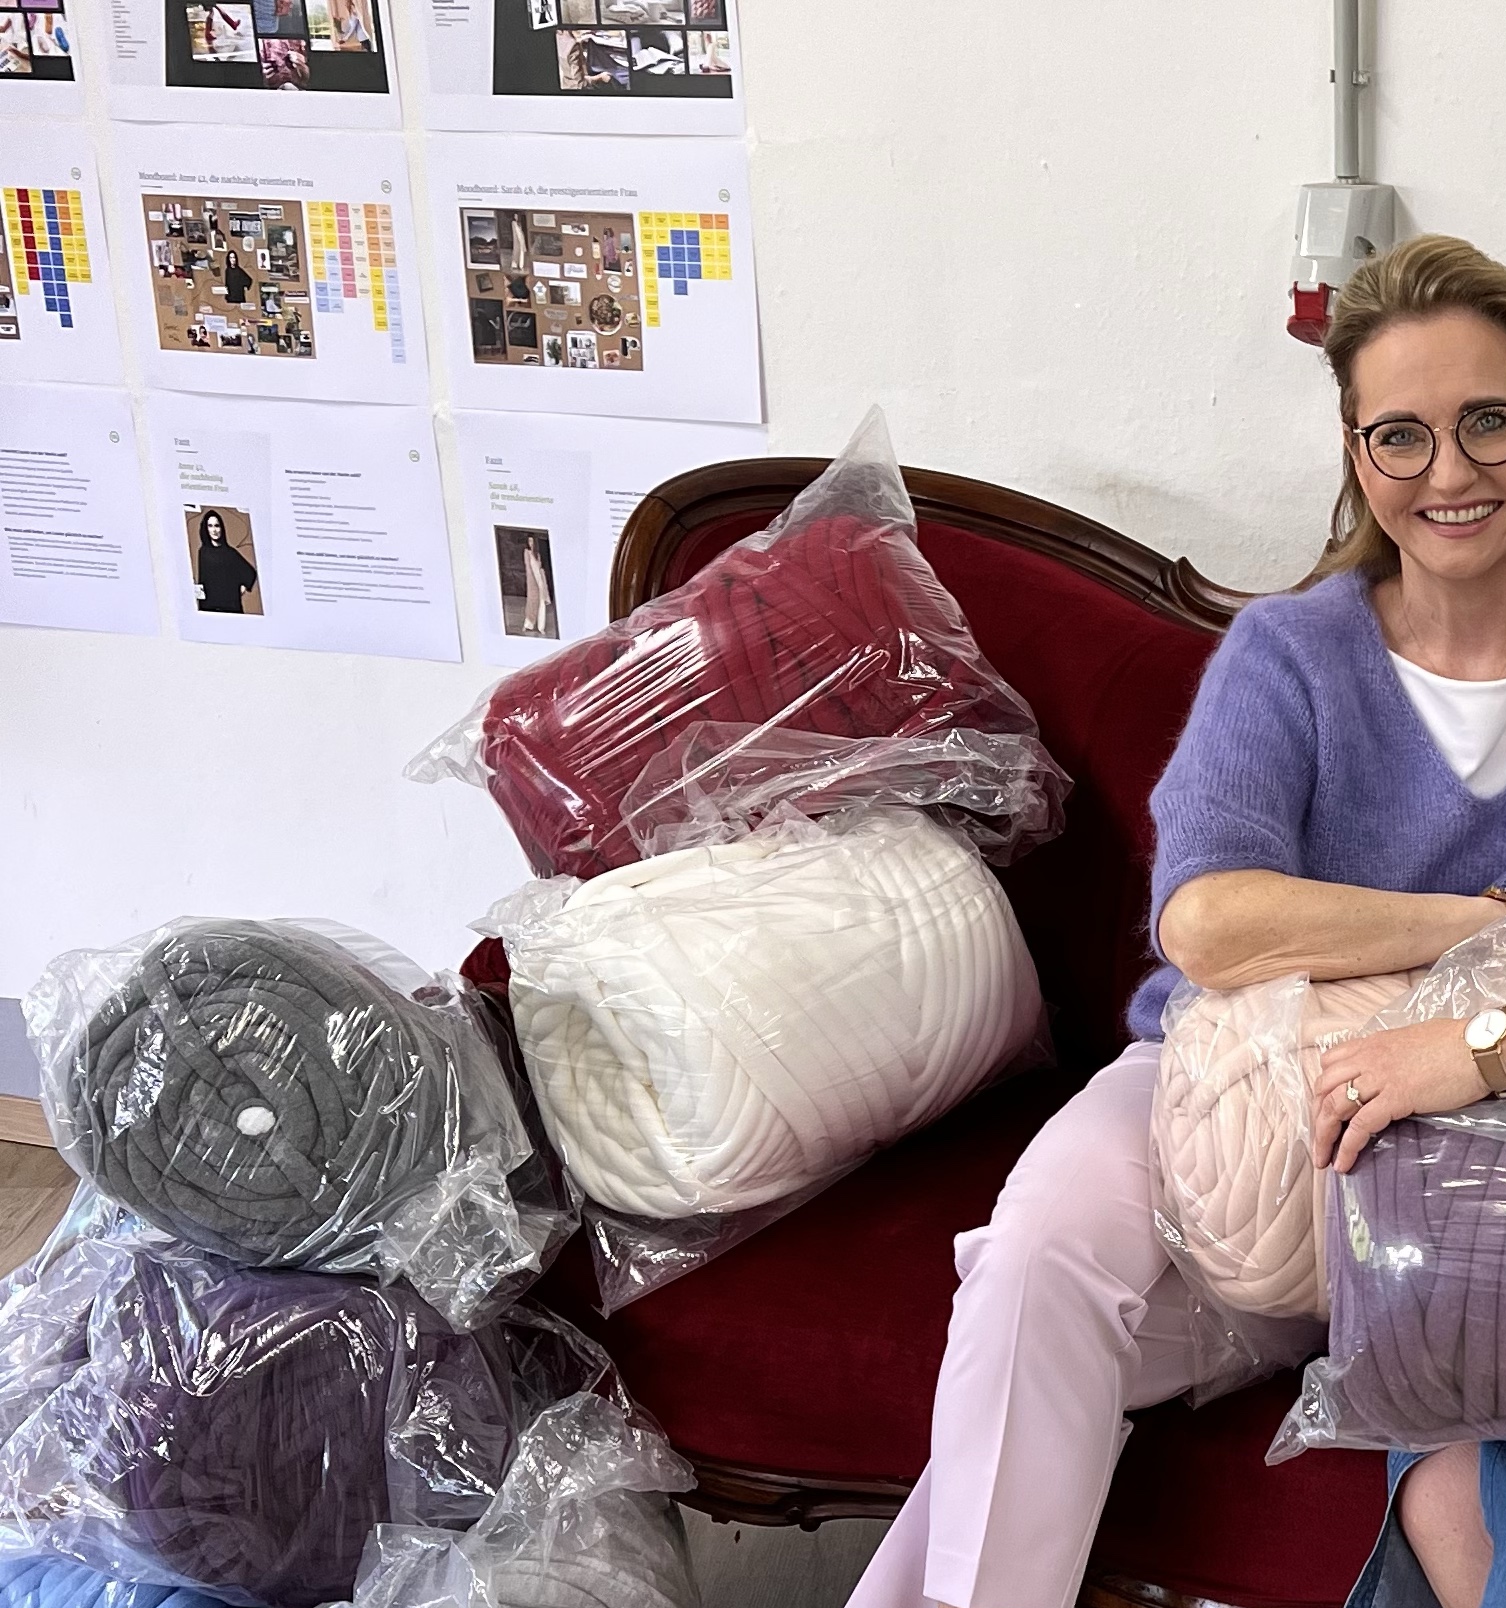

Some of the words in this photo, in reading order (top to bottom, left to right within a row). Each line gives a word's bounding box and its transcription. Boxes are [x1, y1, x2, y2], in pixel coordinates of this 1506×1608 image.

[221, 175, 259, 187] nachhaltig
[501, 185, 523, 195] Sarah
[537, 185, 549, 195] die
